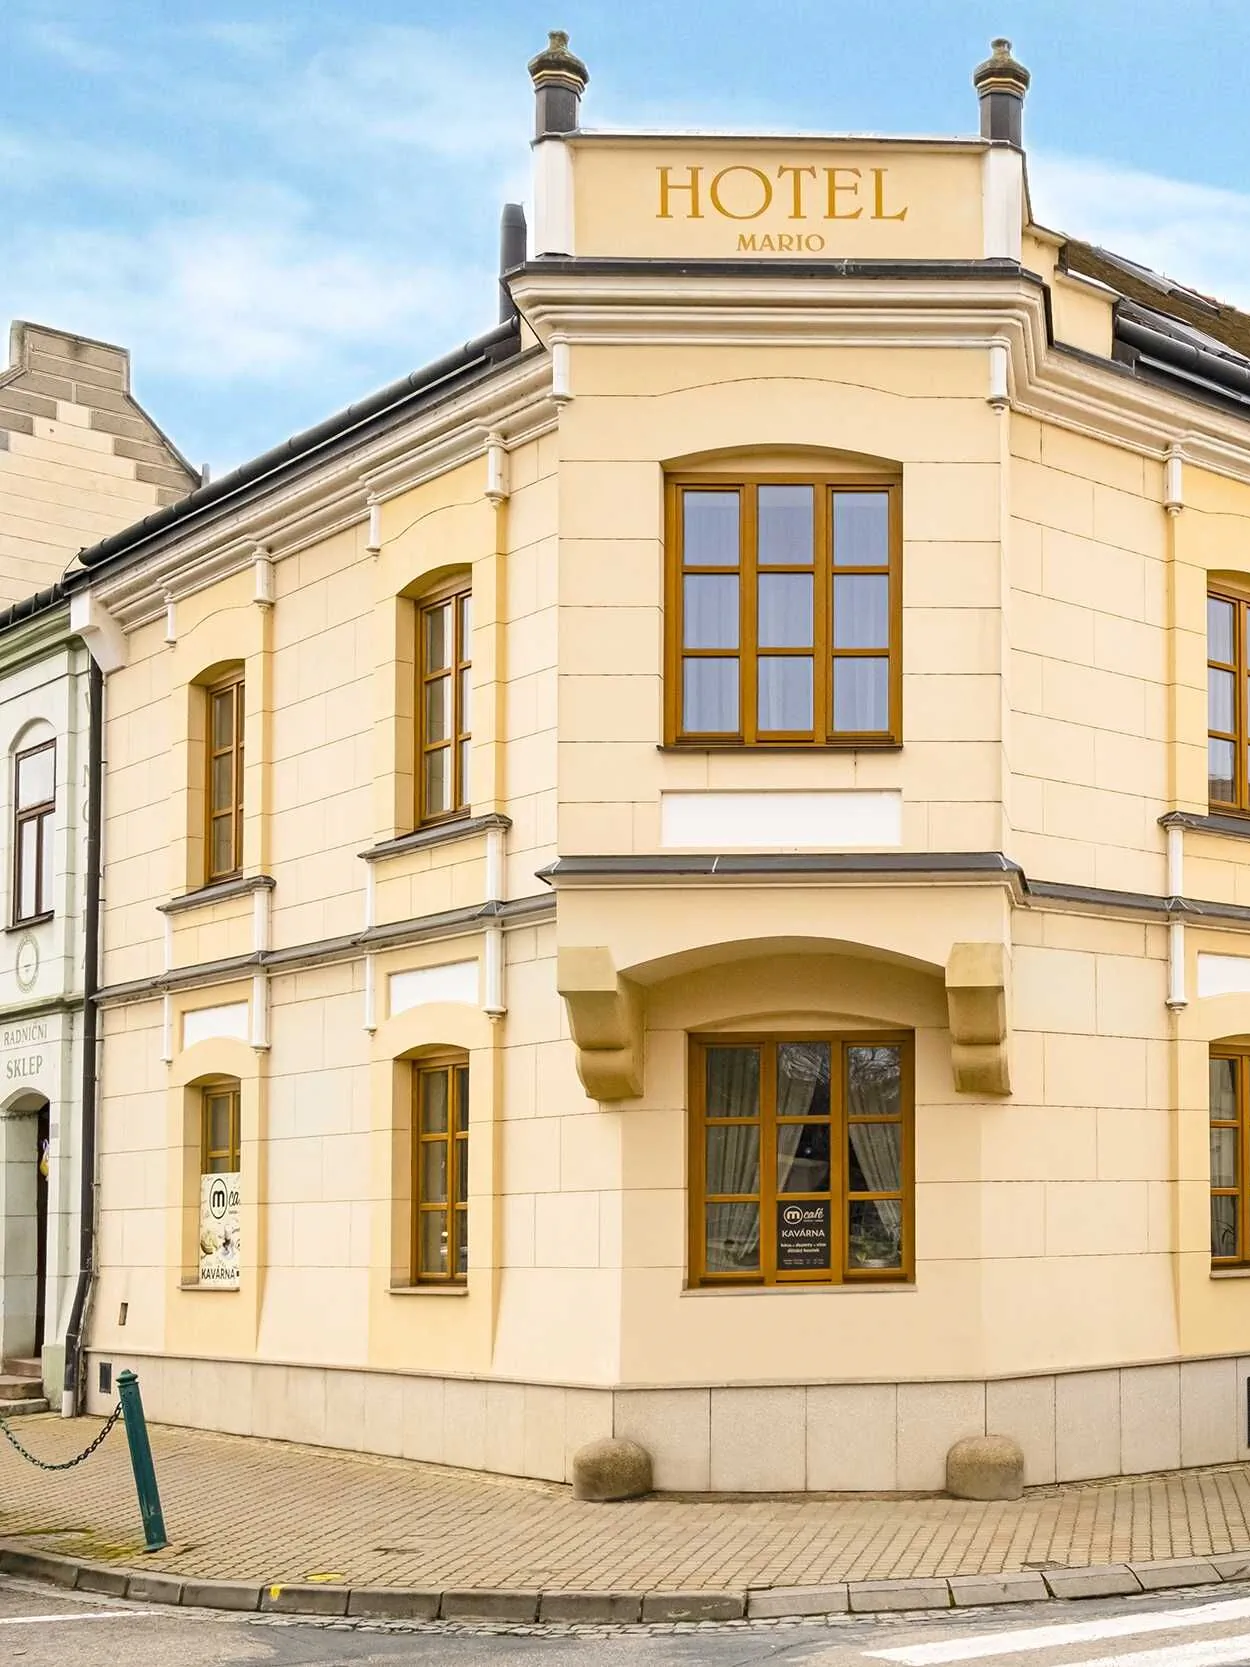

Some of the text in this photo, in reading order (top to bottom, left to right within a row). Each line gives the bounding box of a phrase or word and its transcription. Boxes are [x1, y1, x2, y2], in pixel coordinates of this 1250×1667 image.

[655, 165, 908, 221] HOTEL
[736, 233, 825, 252] MARIO
[6, 1055, 43, 1079] SKLEP
[803, 1207, 824, 1219] café
[782, 1228, 825, 1238] KAVÁRNA
[201, 1265, 235, 1280] KAVÁRNA
